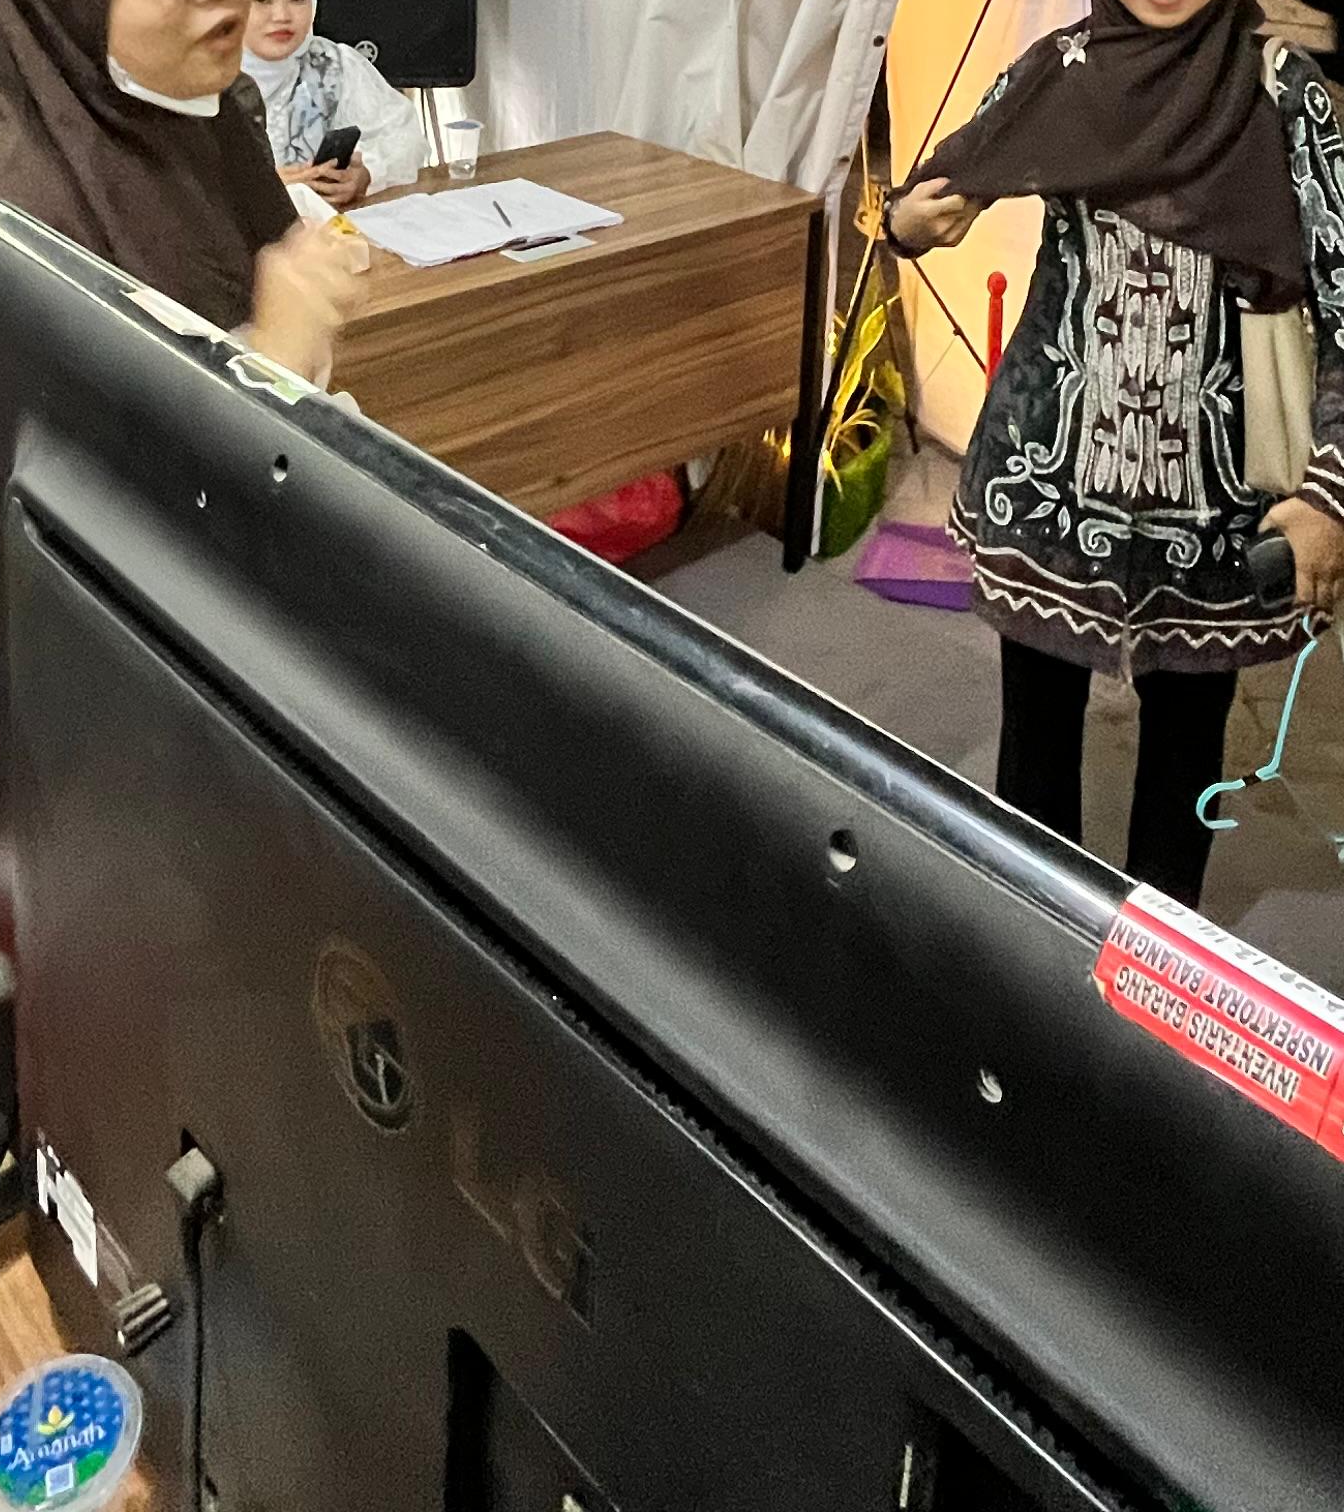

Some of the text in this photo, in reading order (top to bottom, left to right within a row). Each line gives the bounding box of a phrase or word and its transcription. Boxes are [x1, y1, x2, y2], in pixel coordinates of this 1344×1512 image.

[1108, 919, 1205, 993] BALANGAN
[1116, 966, 1299, 1103] INVENTARIS BARANG
[1204, 985, 1334, 1077] INSPEKTORAT
[7, 1422, 107, 1472] Amanah
